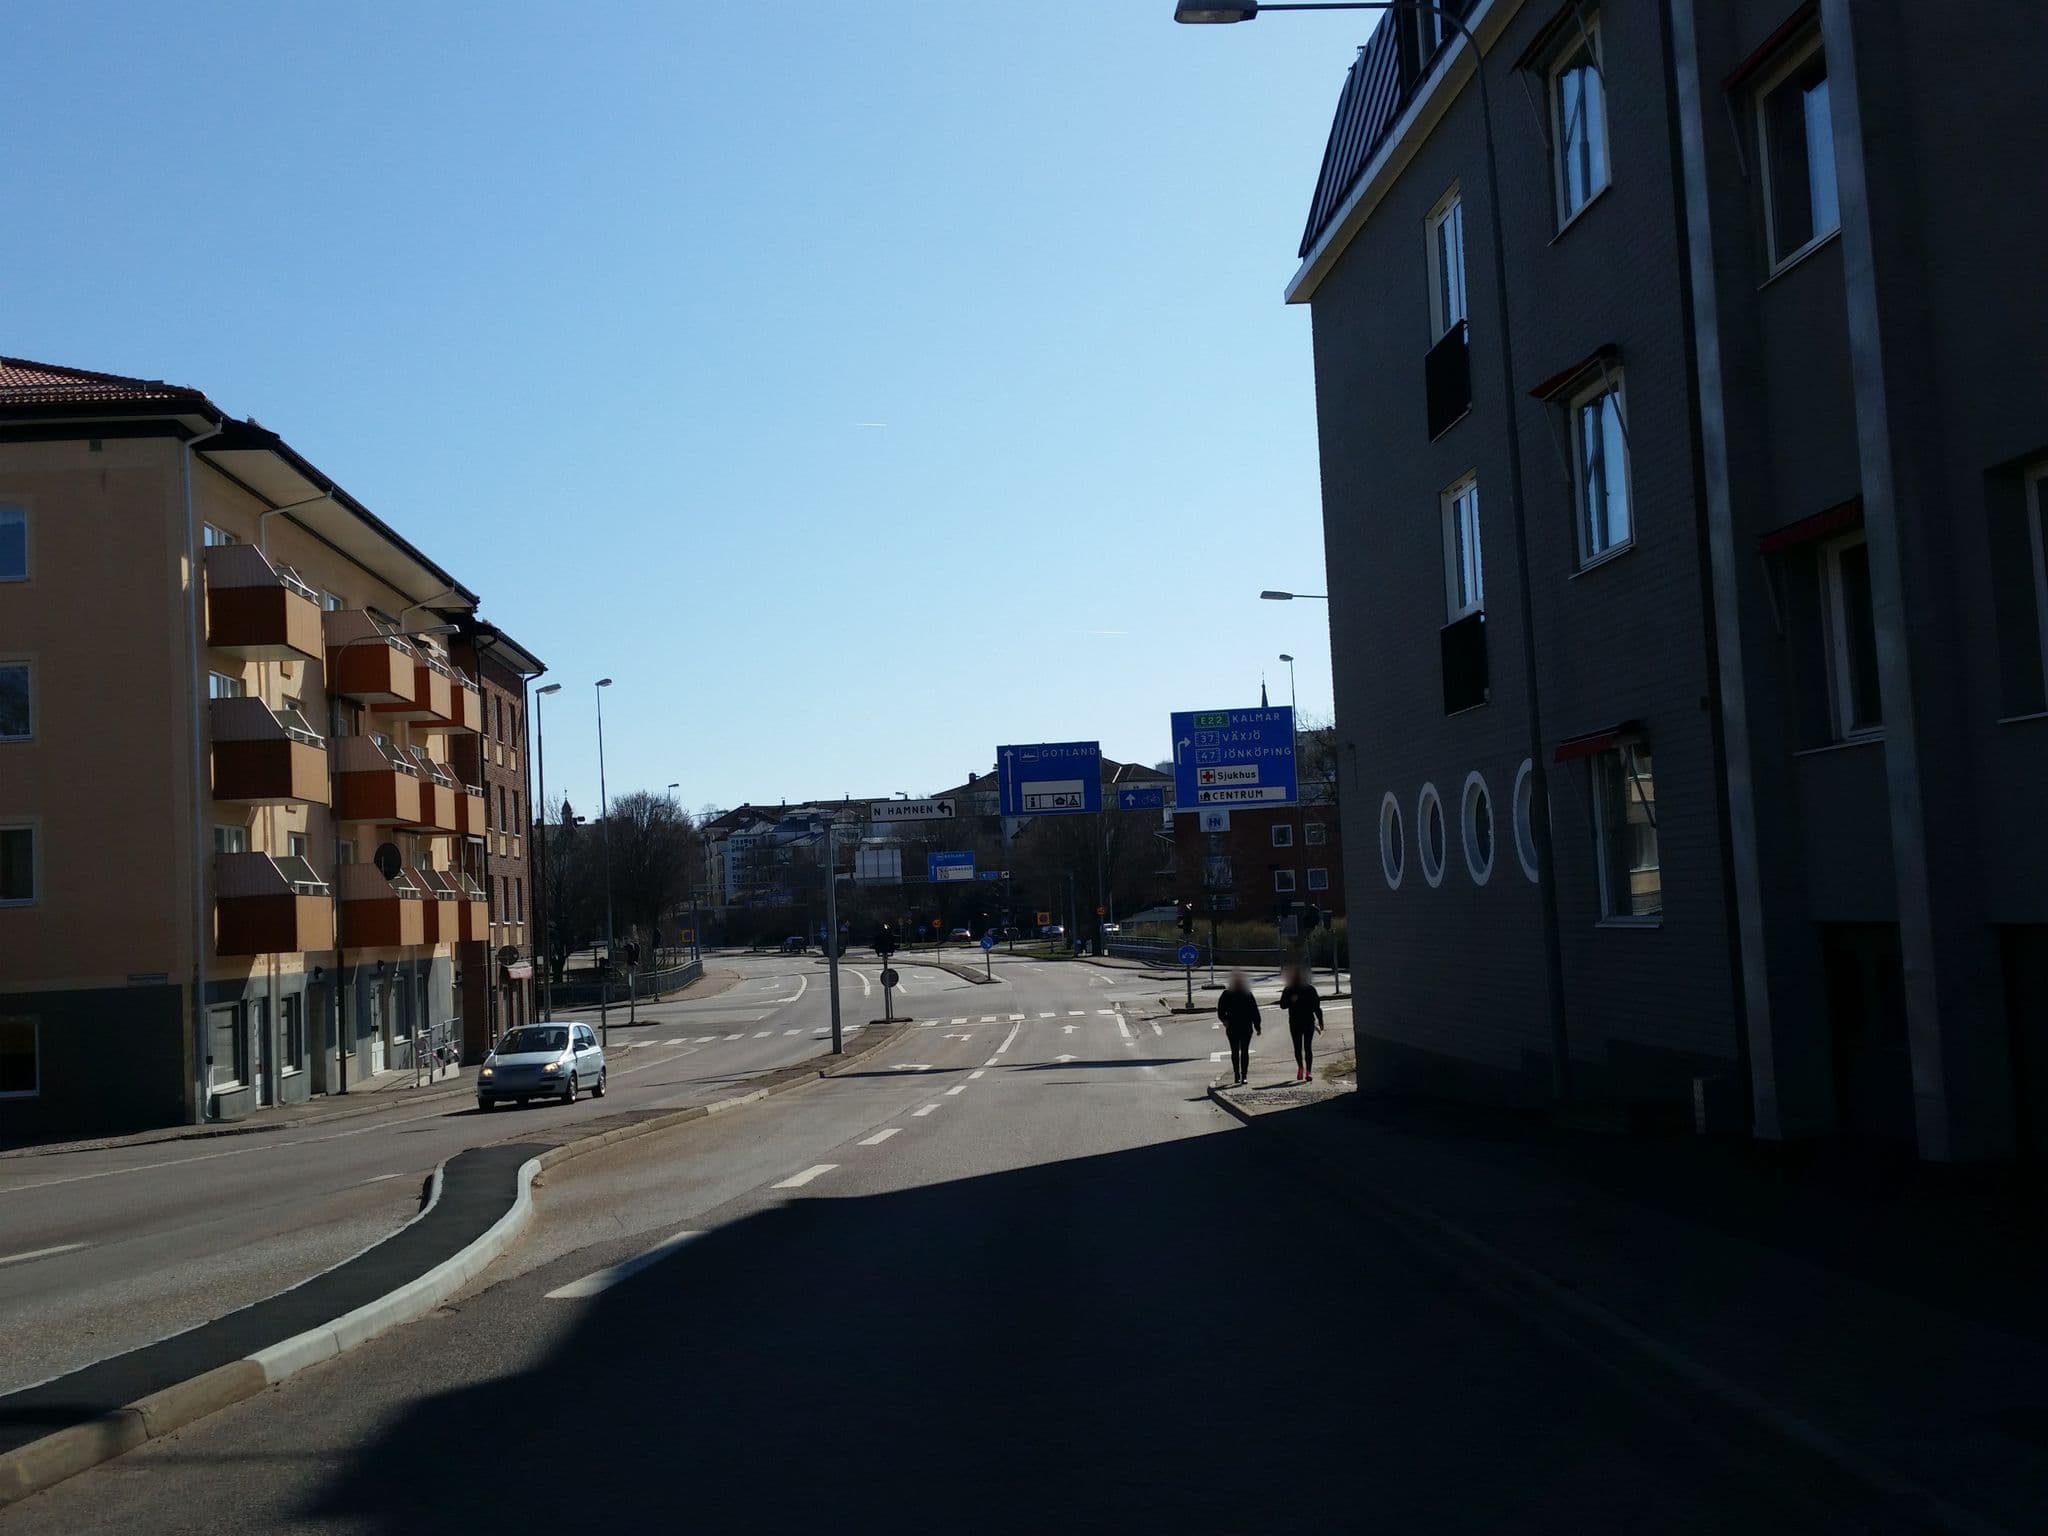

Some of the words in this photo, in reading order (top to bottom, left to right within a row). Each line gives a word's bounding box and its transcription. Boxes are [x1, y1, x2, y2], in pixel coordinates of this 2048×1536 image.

[1200, 716, 1223, 725] E22
[1232, 712, 1280, 723] KALMAR
[1222, 730, 1261, 742] VÄXJÖ
[1042, 747, 1096, 758] GOTLAND
[1223, 747, 1291, 759] JÖNKÖPING
[1217, 771, 1256, 781] Sjukhus
[1213, 790, 1263, 800] CENTRUM
[874, 808, 881, 816] N
[888, 806, 933, 815] HAMNEN
